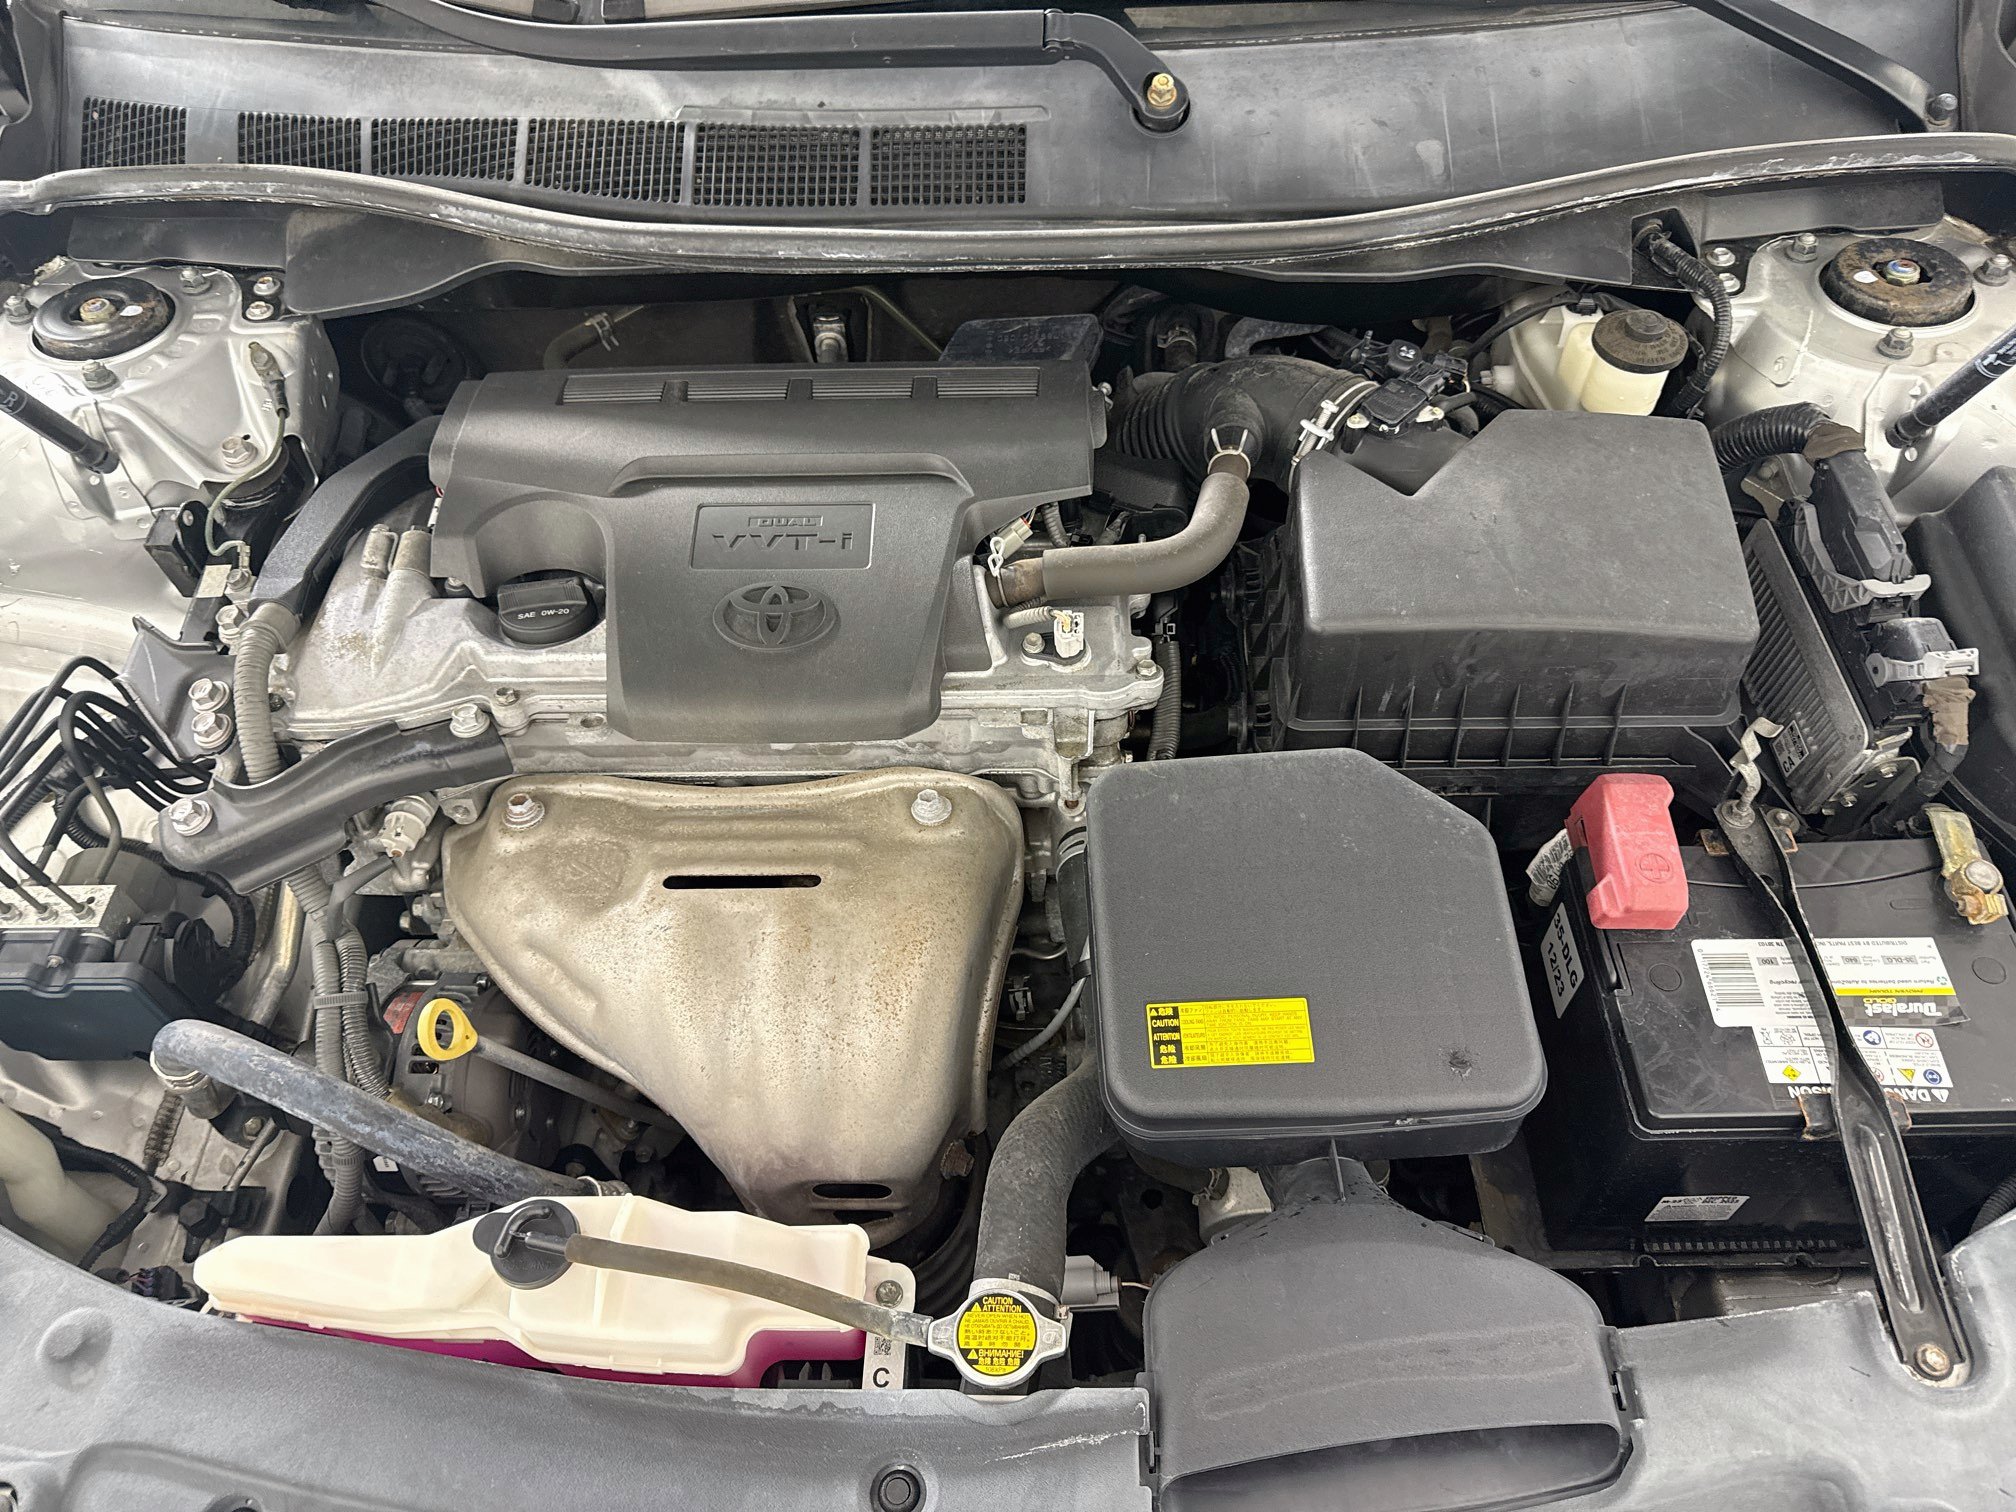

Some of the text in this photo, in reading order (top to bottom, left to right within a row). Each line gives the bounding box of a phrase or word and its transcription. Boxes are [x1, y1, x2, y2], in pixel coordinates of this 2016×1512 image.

[759, 517, 818, 527] DUAL
[712, 532, 854, 552] VVT-i
[517, 608, 570, 620] SAE 0W-20
[1553, 912, 1579, 989] 35-DLG
[1546, 941, 1565, 998] 12/23
[1863, 1002, 1943, 1017] Duralast
[1151, 1018, 1180, 1028] CAUTION
[1153, 1032, 1181, 1041] ATTENTION
[1883, 1087, 1932, 1102] DAN
[982, 1296, 1013, 1305] CAUTION
[982, 1304, 1022, 1313] ATTENTION
[978, 1349, 1024, 1358] ВНИМАНИЕ!
[872, 1367, 890, 1389] C
